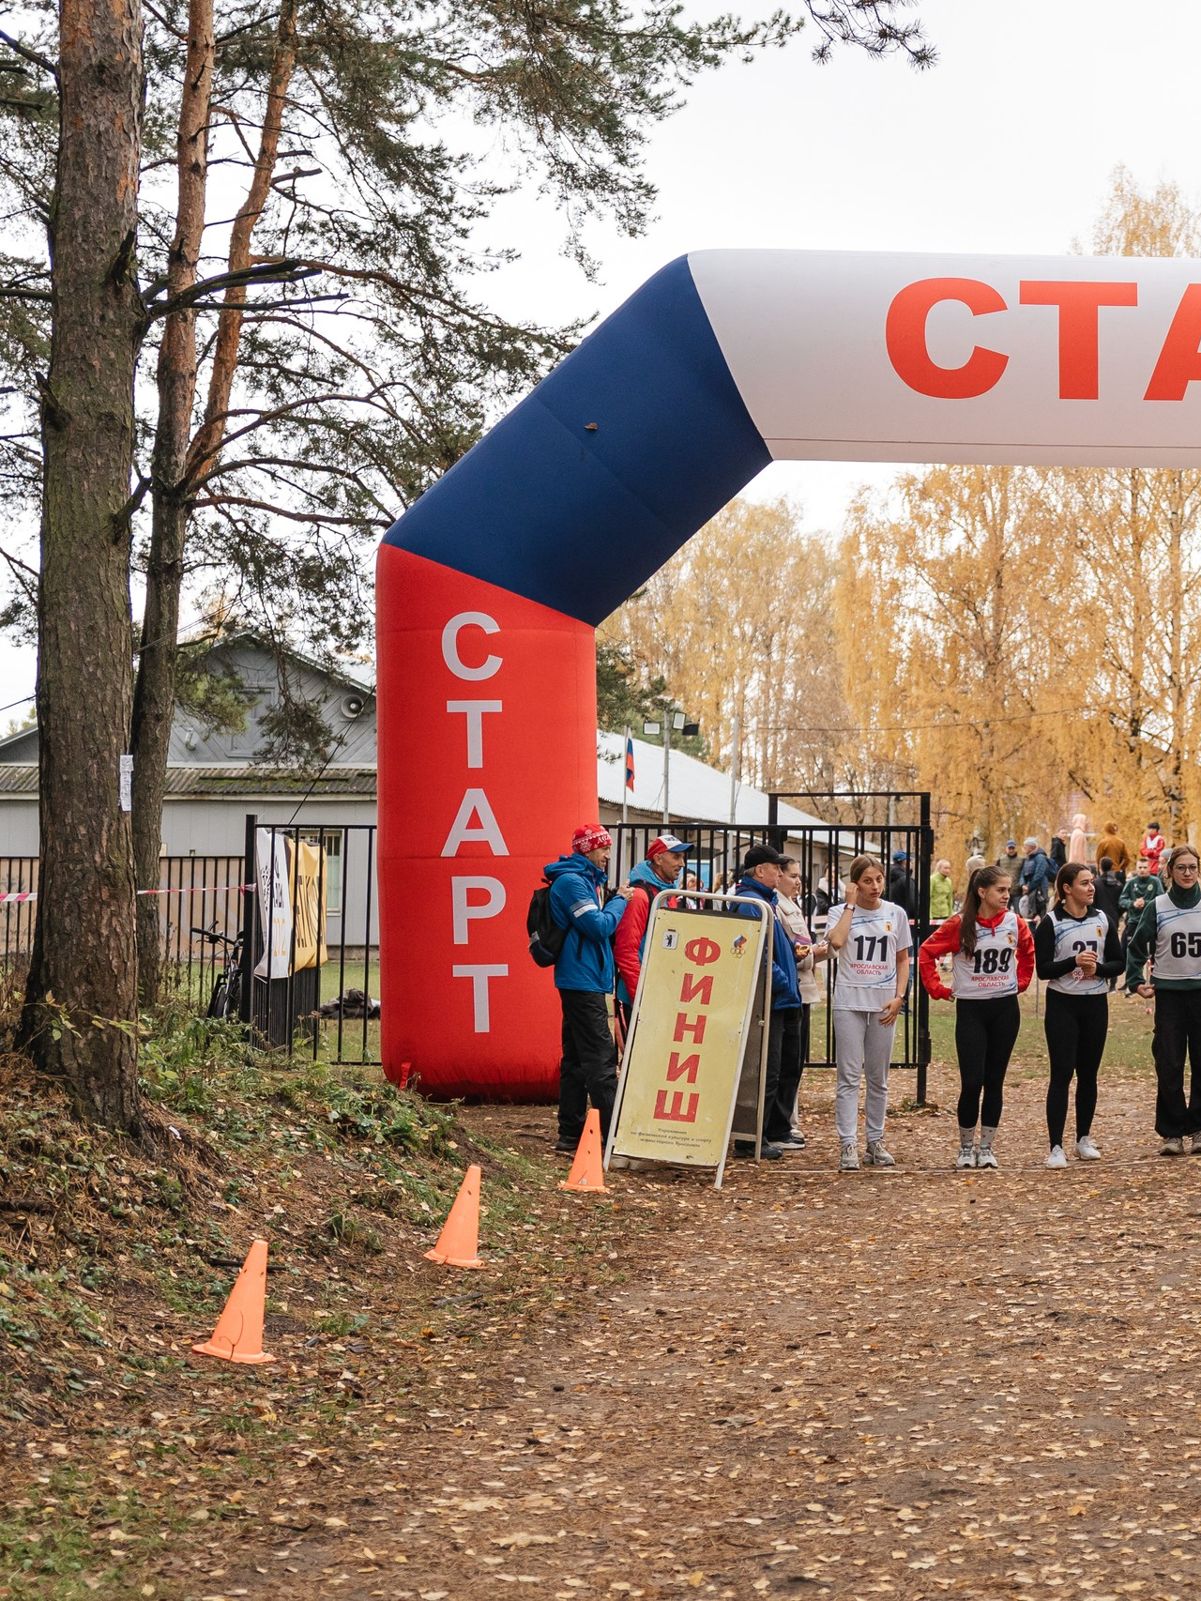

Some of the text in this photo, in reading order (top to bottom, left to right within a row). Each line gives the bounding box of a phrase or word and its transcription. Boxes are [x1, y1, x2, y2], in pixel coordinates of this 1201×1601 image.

[440, 611, 510, 1033] СТАРТ
[853, 934, 889, 962] 171
[973, 947, 1012, 974] 189
[653, 936, 721, 1123] ФИНИШ
